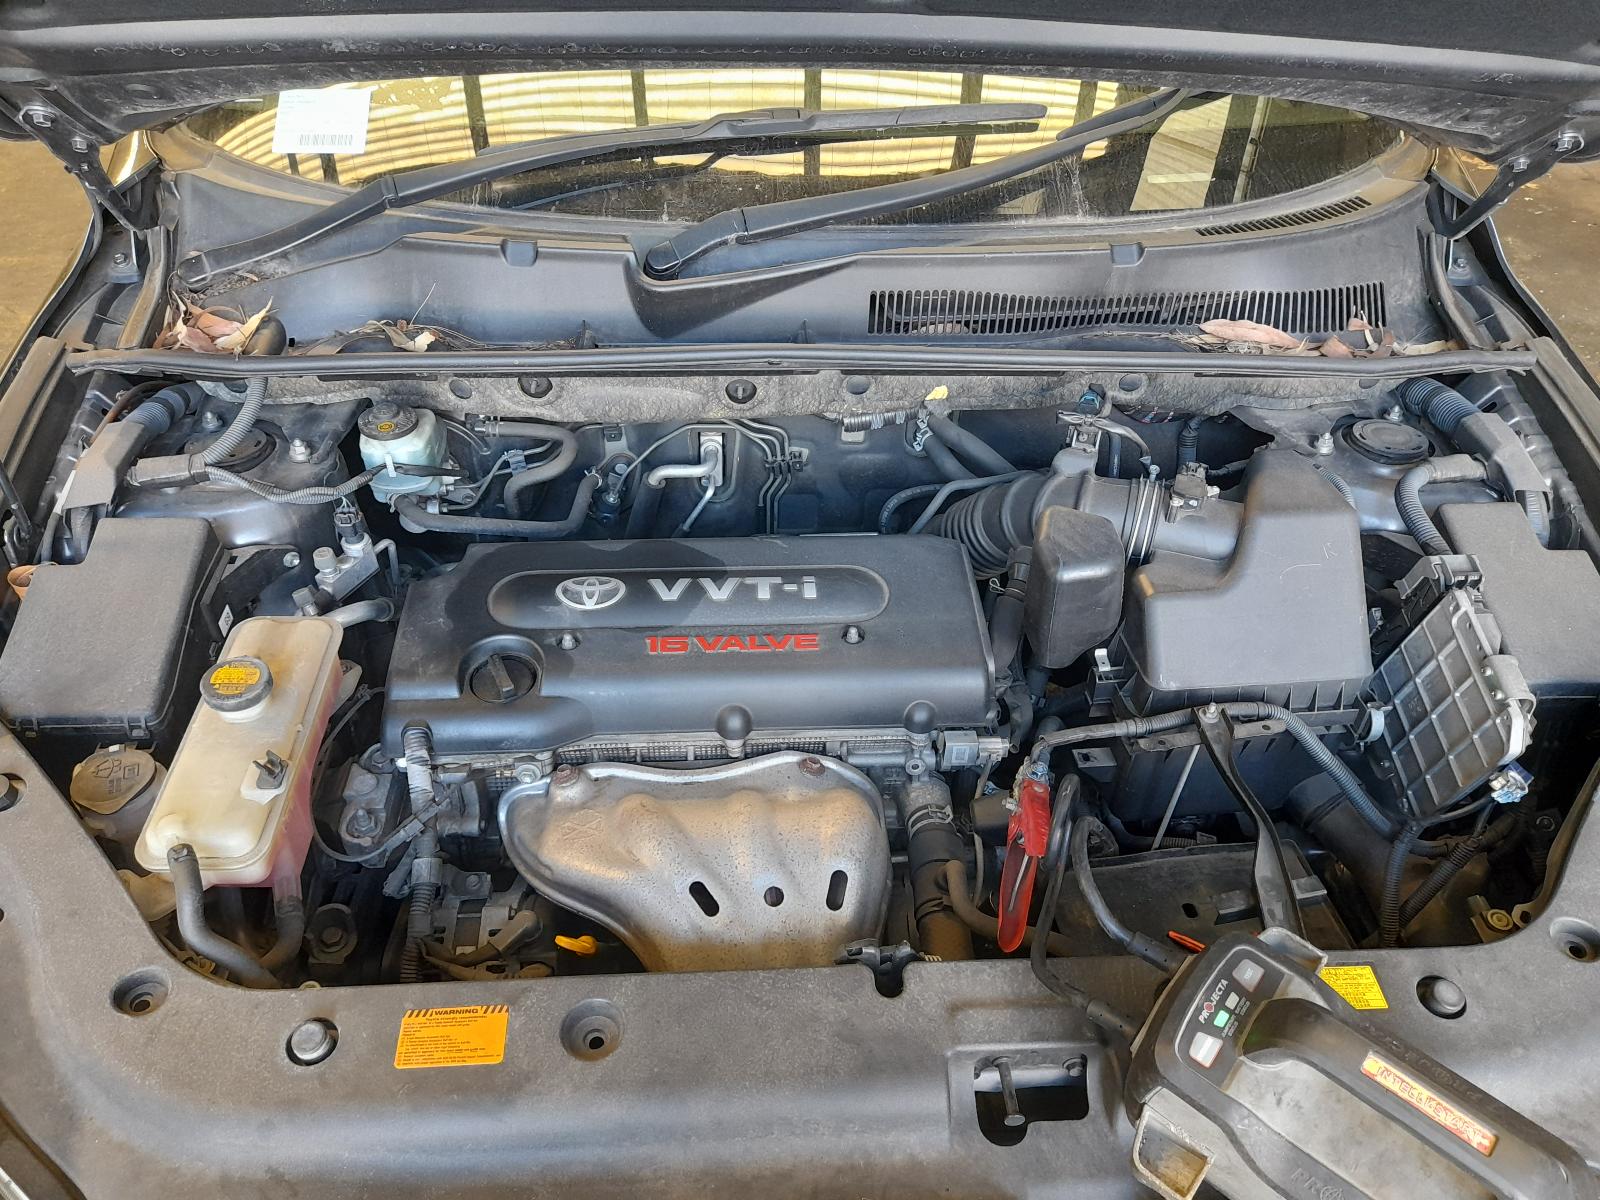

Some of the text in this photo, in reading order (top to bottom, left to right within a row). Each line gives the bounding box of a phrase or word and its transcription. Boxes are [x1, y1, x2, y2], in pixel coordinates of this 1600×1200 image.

[648, 576, 817, 601] VVT-i
[645, 633, 820, 655] 16 VALVE
[434, 1007, 480, 1016] WARNING
[1199, 978, 1229, 1025] PROJECTA
